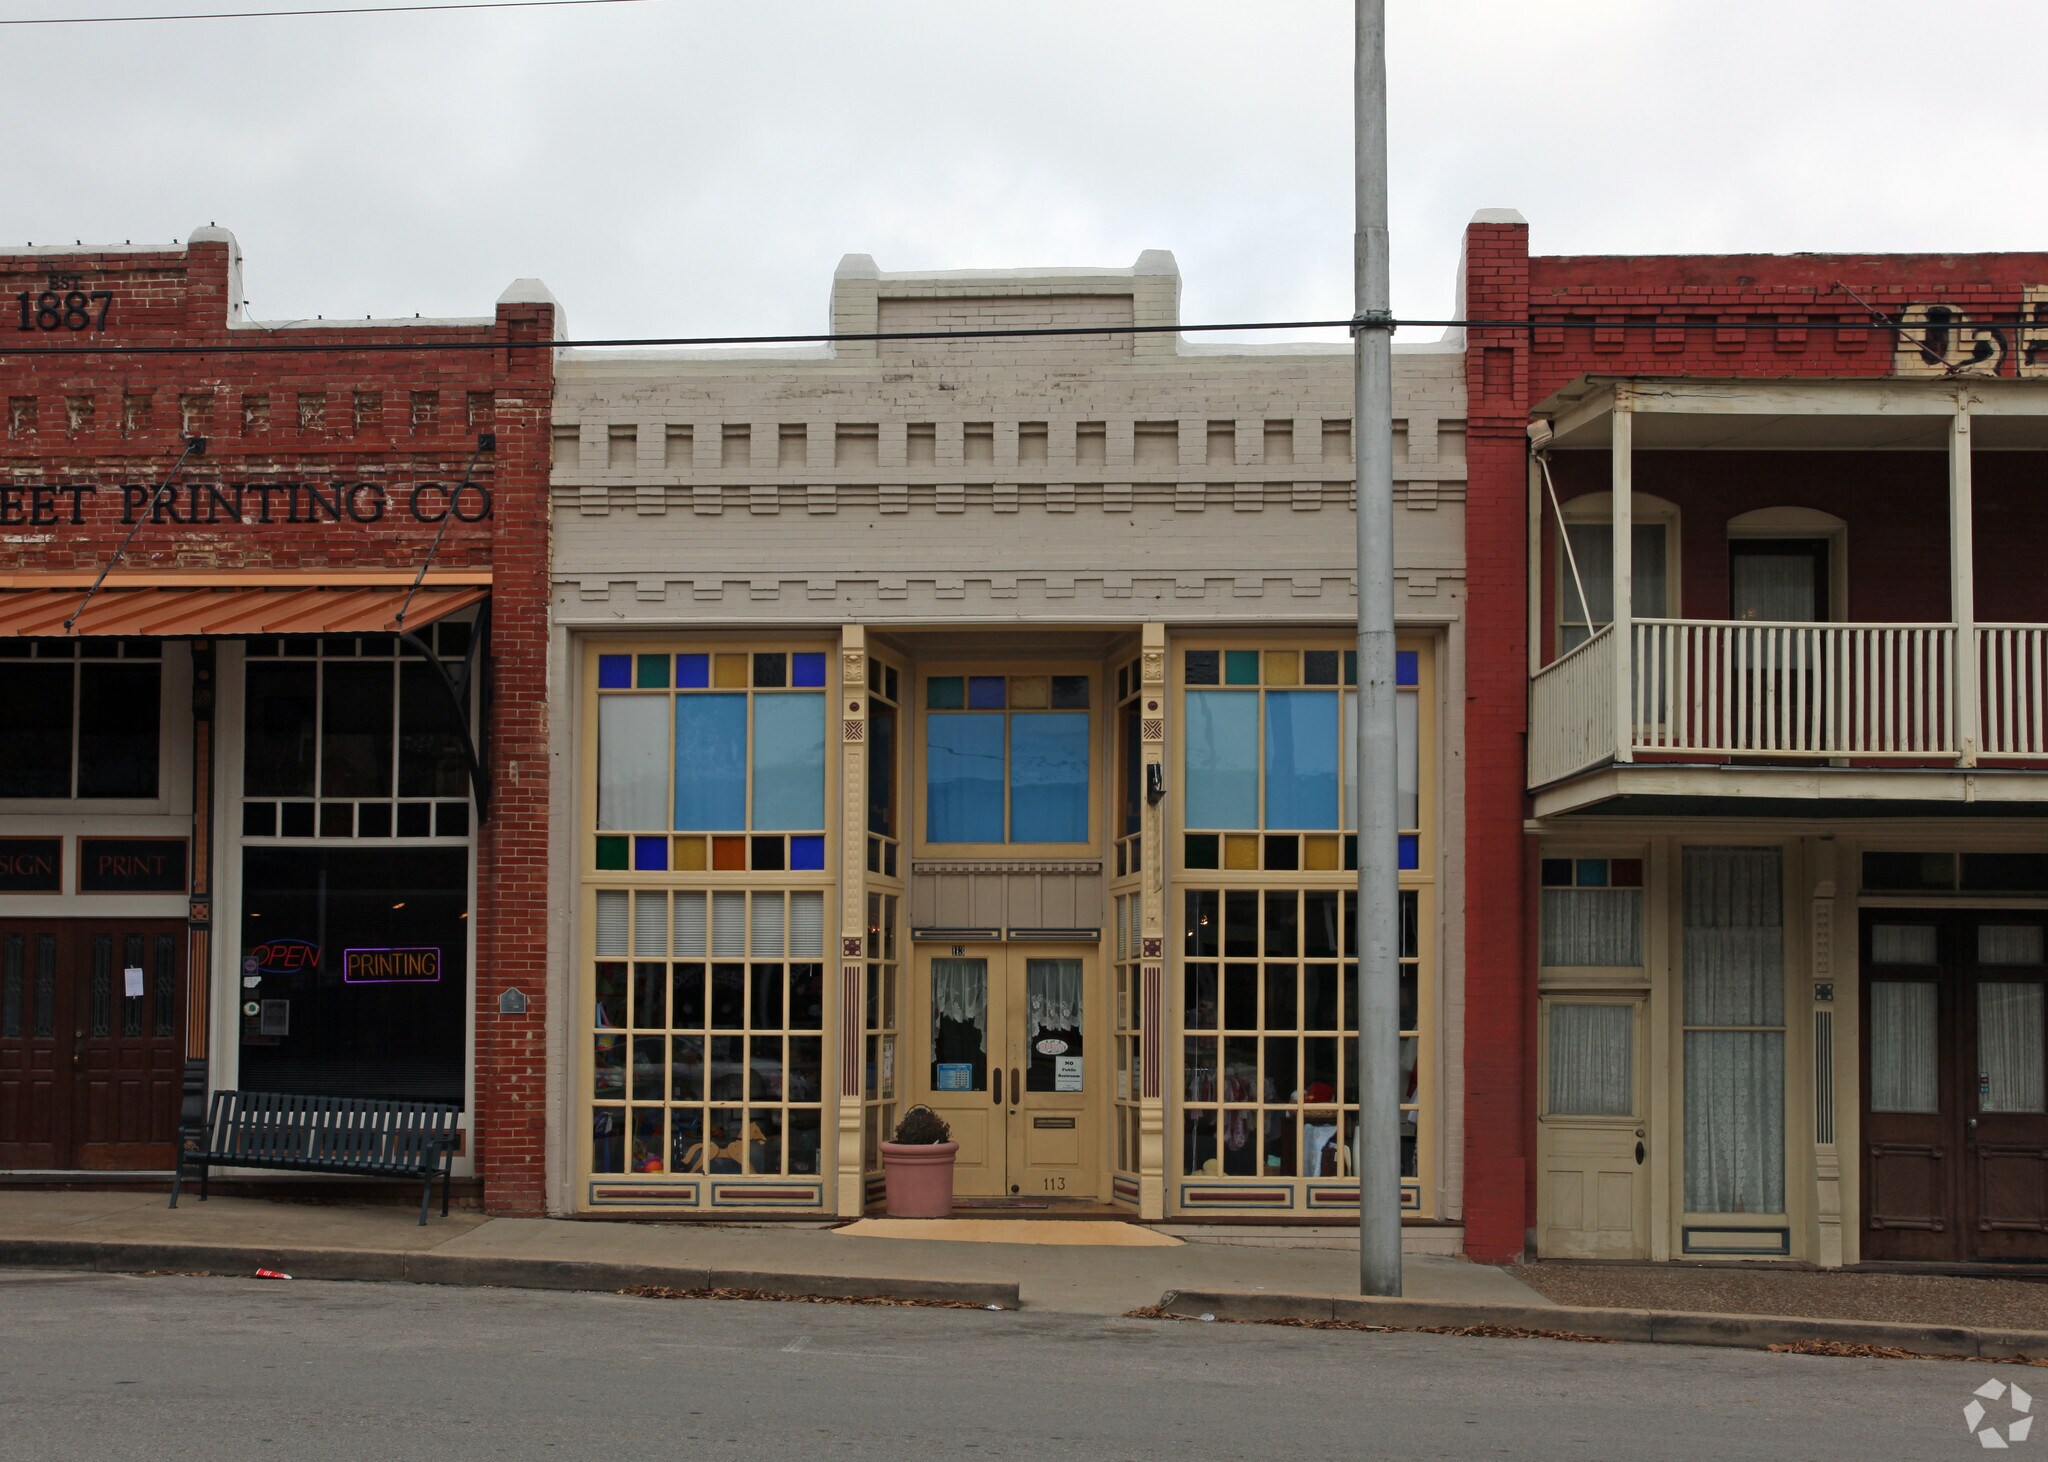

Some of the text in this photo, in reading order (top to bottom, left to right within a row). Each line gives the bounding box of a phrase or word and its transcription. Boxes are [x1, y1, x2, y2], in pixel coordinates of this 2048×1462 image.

[48, 275, 84, 290] EST.
[15, 290, 113, 331] 1887
[0, 484, 97, 526] EET
[119, 482, 386, 525] PRINTING
[98, 855, 166, 877] PRINT
[250, 945, 321, 967] OPEN
[952, 946, 966, 957] 113
[348, 952, 436, 977] PRINTING
[1044, 1177, 1066, 1191] 113
